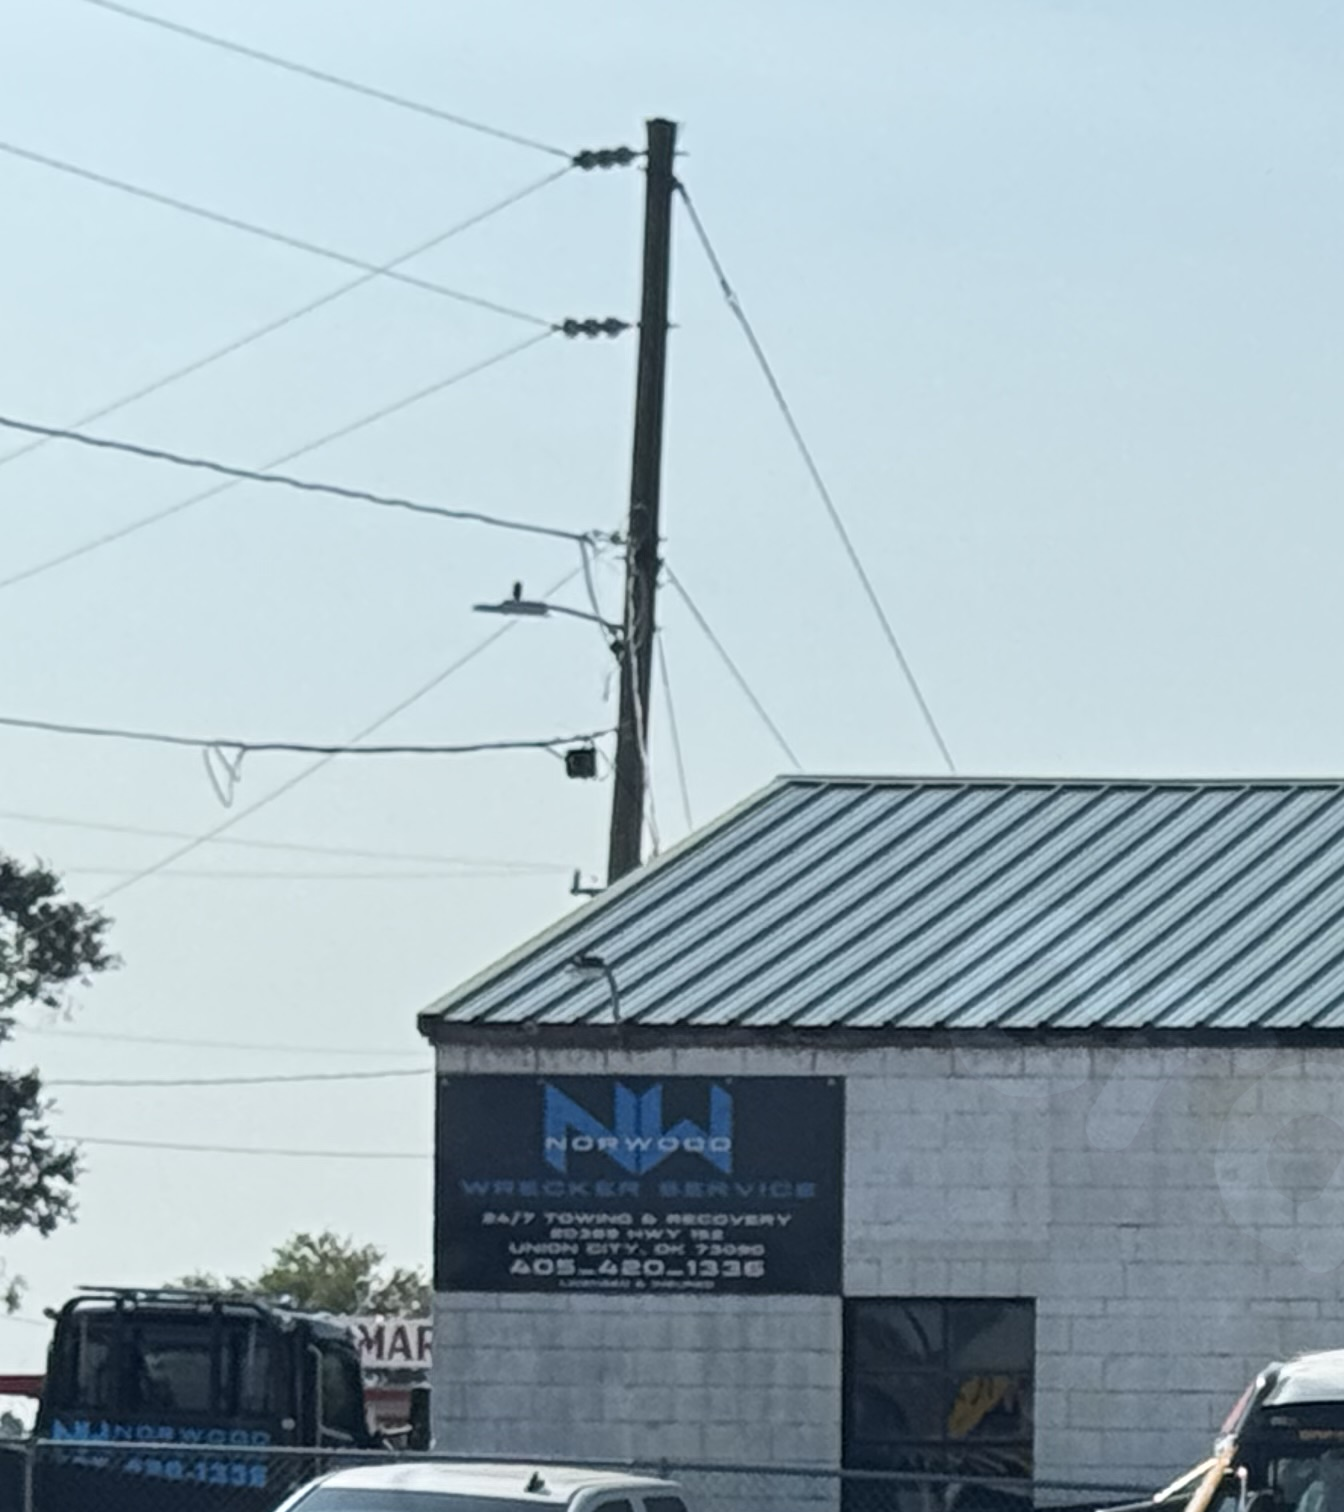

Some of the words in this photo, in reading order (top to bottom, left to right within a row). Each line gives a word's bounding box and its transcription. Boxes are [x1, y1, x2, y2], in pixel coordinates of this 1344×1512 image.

[545, 1136, 732, 1152] NORWOOD
[461, 1180, 640, 1197] WRECKER
[659, 1181, 816, 1198] SERVICE
[482, 1212, 536, 1227] 24/7
[544, 1212, 633, 1226] TOWING
[641, 1213, 657, 1226] &
[666, 1213, 793, 1227] RECOVERY
[627, 1229, 682, 1241] HWY
[508, 1242, 580, 1255] UNION
[654, 1243, 686, 1255] OK
[696, 1244, 766, 1256] 73090
[113, 1424, 272, 1446] NORWOOD
